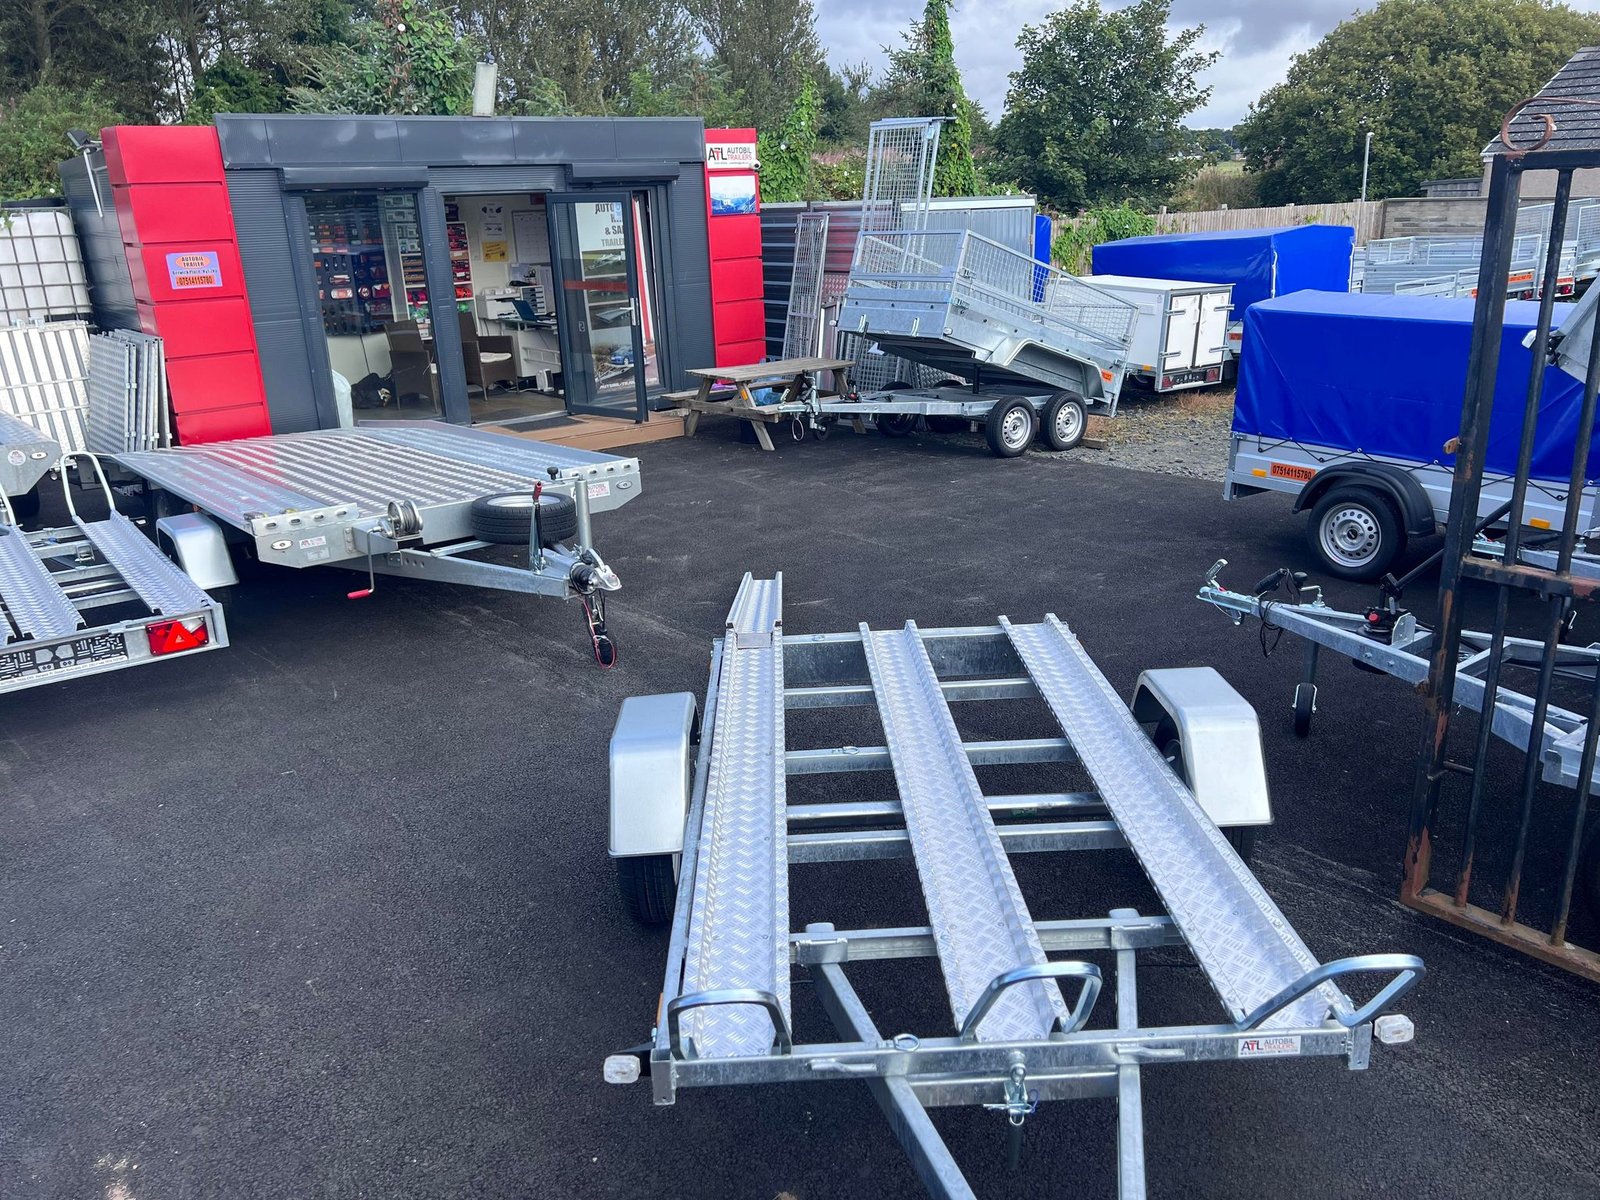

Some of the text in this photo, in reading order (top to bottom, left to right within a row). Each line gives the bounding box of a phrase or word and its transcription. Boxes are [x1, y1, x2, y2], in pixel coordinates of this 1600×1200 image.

[708, 147, 727, 160] ATL
[1272, 465, 1312, 480] 07514115780
[1241, 1037, 1295, 1052] ATL AUTOBIL
[1264, 1042, 1297, 1051] TRAILERS
